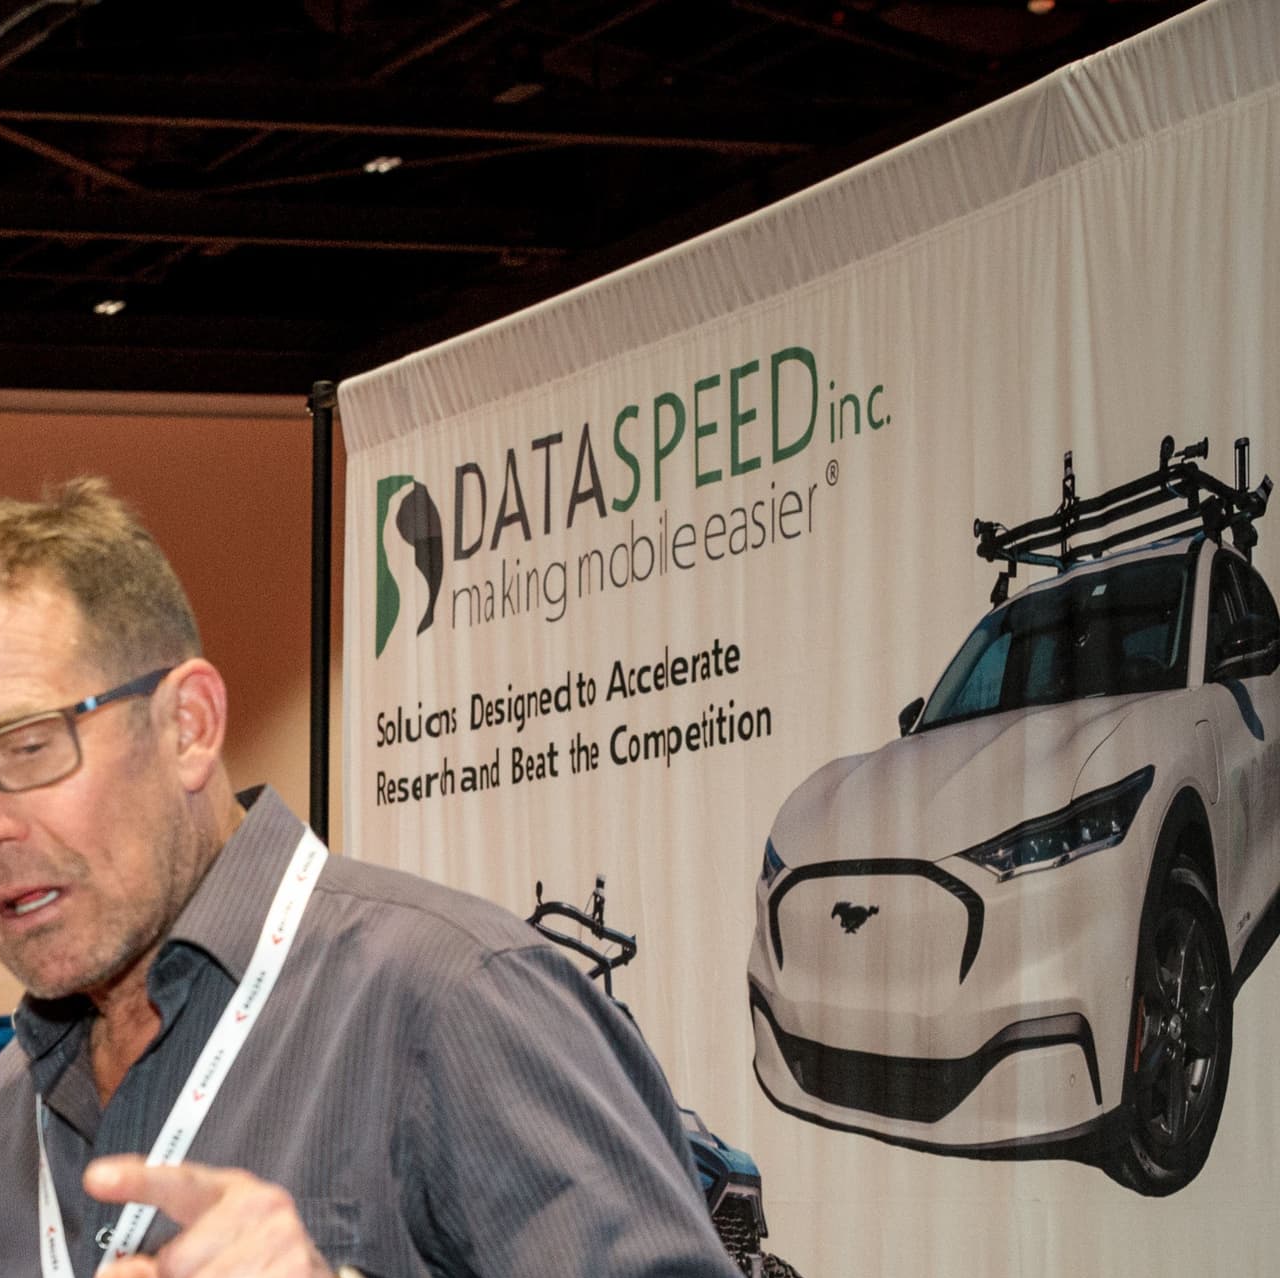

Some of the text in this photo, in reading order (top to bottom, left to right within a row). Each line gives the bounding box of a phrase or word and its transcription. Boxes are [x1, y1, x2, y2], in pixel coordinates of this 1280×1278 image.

[453, 346, 891, 561] DATASPEED inc.
[452, 558, 567, 629] making
[578, 508, 697, 598] mobile
[376, 638, 741, 748] Soluions Designed to Accelerate
[460, 747, 501, 792] and
[511, 742, 559, 784] Beat
[569, 732, 600, 774] the
[610, 699, 772, 768] Competition
